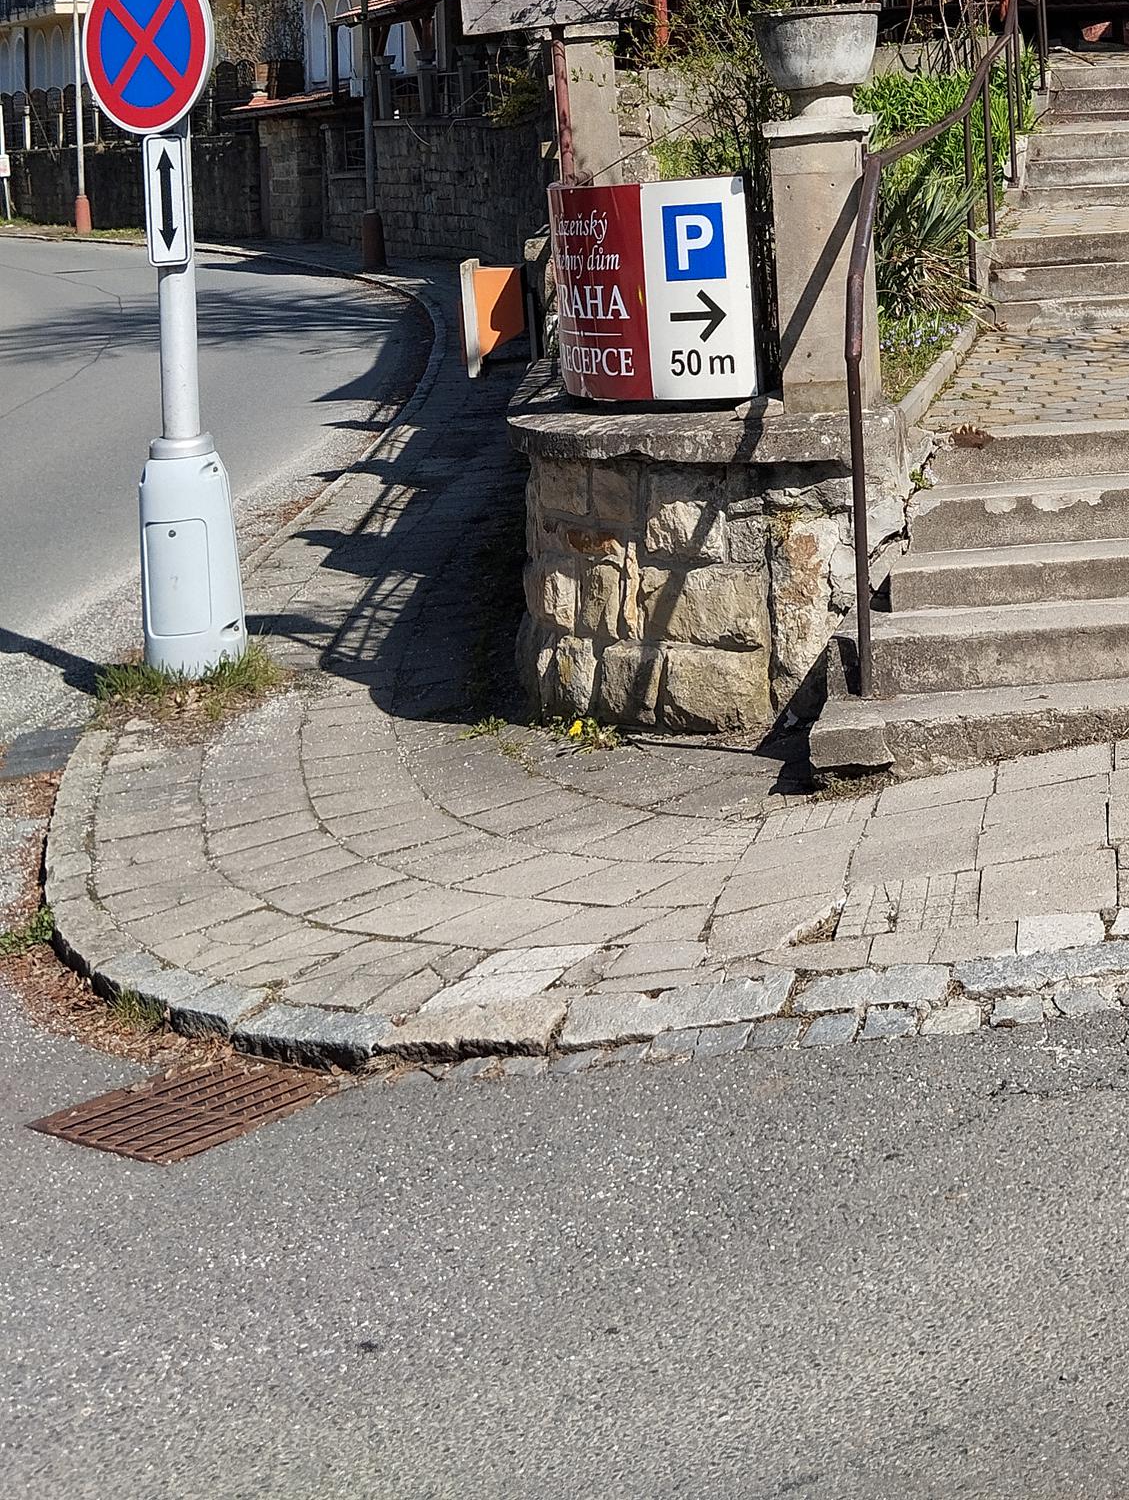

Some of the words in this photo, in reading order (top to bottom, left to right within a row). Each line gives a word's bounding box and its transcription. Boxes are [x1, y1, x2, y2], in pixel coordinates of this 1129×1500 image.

[675, 214, 714, 271] P
[586, 245, 622, 272] dům
[670, 349, 702, 377] 50
[708, 353, 736, 375] m
